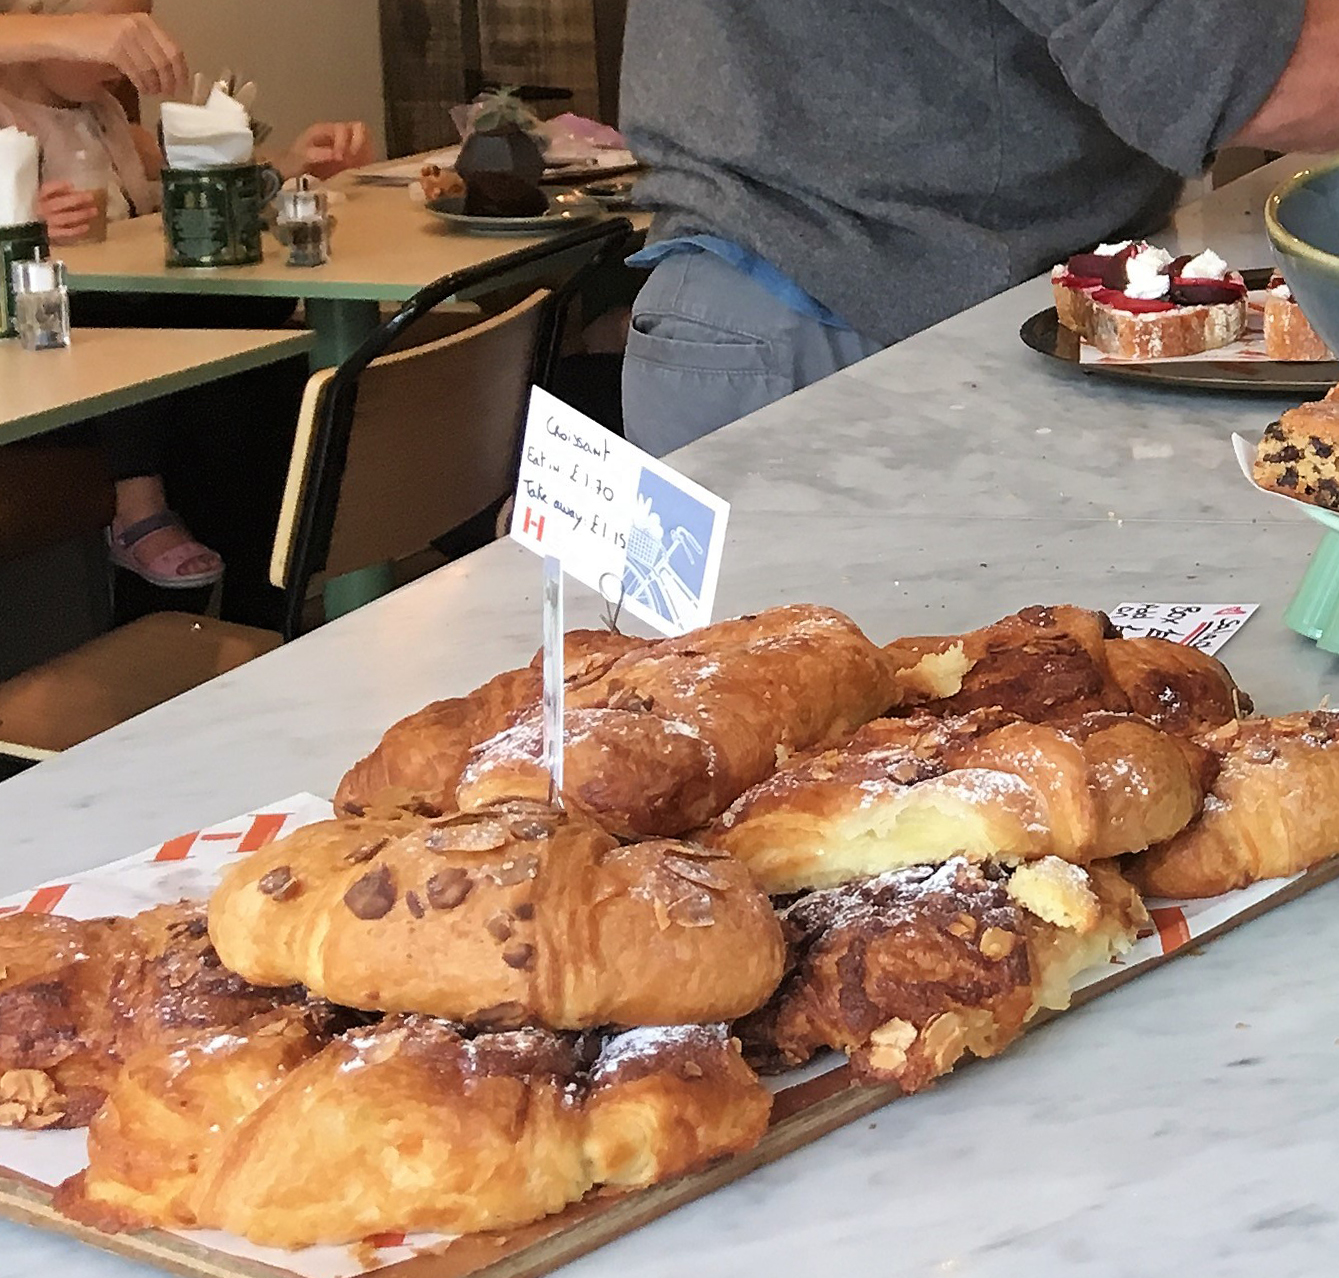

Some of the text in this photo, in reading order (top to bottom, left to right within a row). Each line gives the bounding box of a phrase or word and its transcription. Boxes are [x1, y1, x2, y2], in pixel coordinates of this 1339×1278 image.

[527, 446, 546, 468] Eat
[523, 479, 548, 504] Take
[522, 506, 546, 542] H
